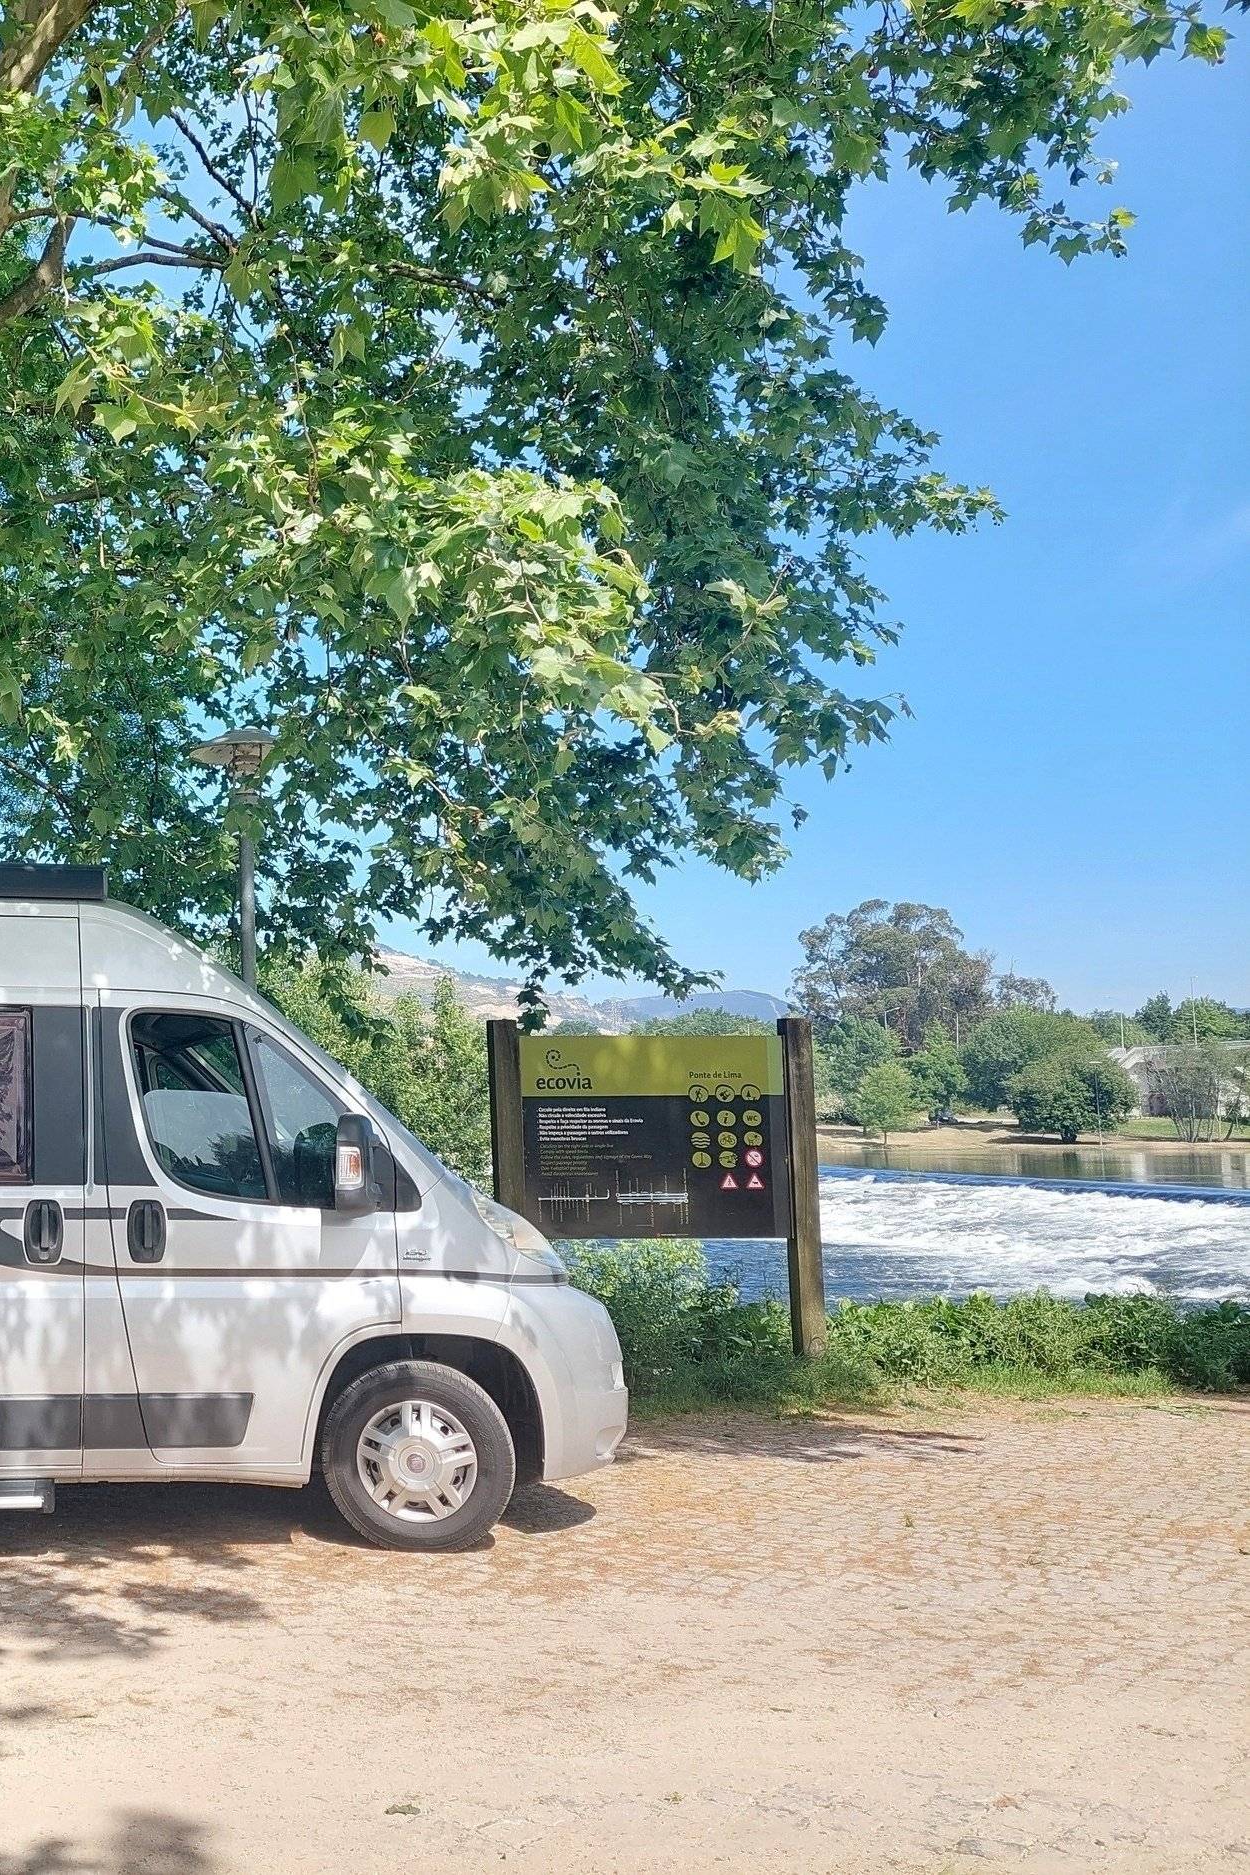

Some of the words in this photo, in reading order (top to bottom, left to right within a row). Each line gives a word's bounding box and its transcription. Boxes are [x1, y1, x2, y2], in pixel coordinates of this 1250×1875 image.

[689, 1071, 711, 1079] Ponte
[712, 1071, 722, 1079] de
[723, 1071, 742, 1079] Lima
[536, 1073, 593, 1090] ecovia
